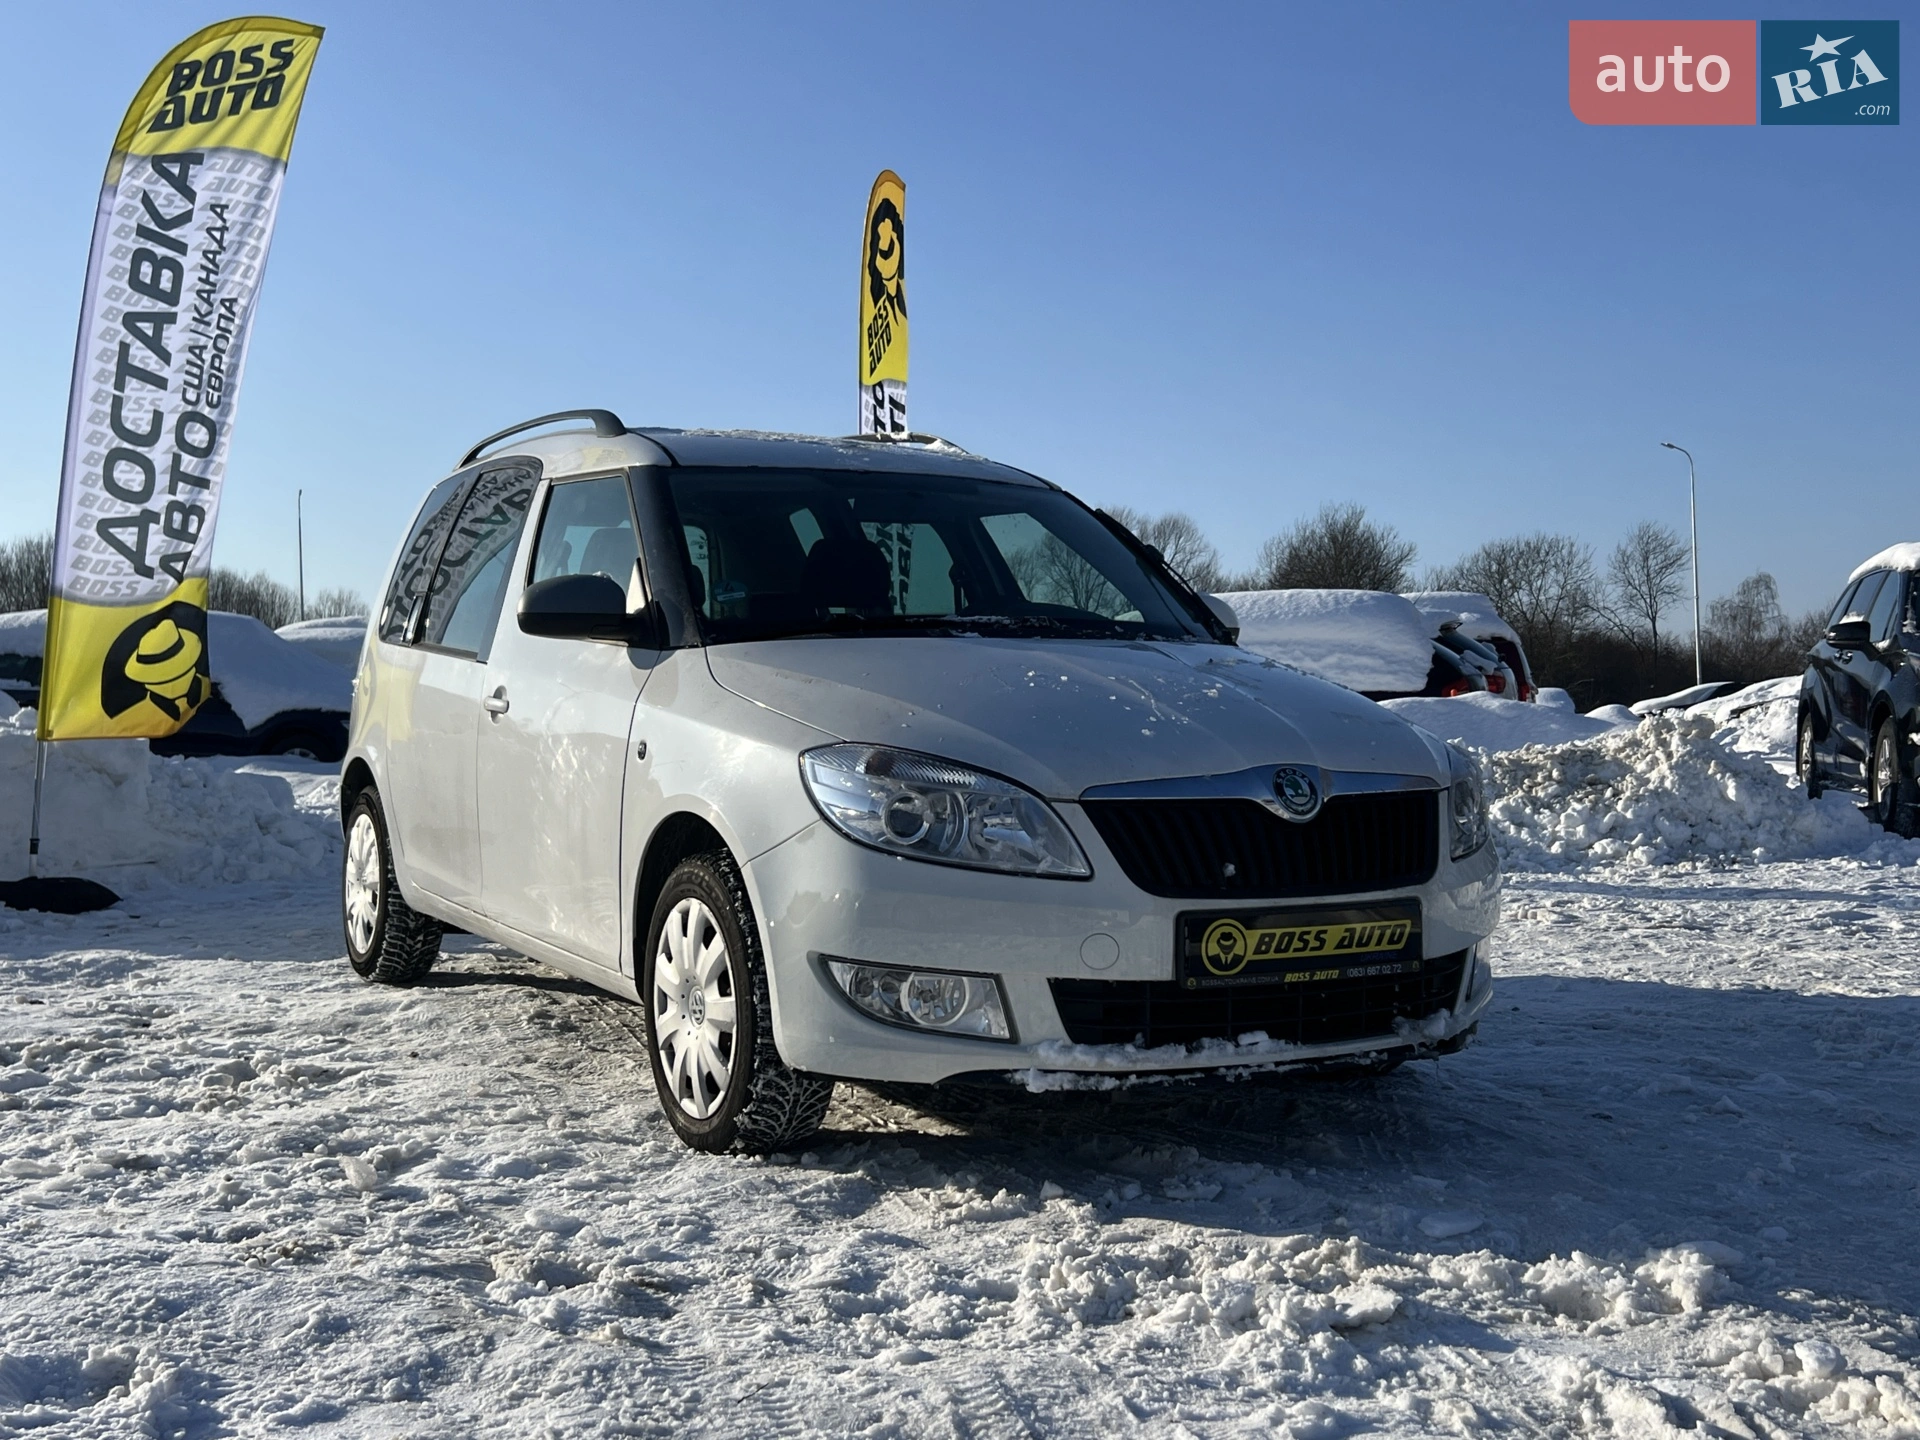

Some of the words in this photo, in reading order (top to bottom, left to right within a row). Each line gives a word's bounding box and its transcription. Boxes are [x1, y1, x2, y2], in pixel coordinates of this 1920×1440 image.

[166, 38, 295, 97] BOSS
[146, 74, 286, 134] AUTO
[191, 203, 229, 327] КАНАДА
[867, 298, 889, 351] BOSS
[868, 320, 892, 378] AUTO
[96, 152, 204, 579] ДОСТАВКА
[182, 344, 208, 407] США
[158, 410, 218, 585] АВТО
[1252, 929, 1328, 956] BOSS
[1333, 924, 1406, 950] AUTO
[1284, 972, 1310, 983] BOSS
[1312, 969, 1340, 981] AUTO
